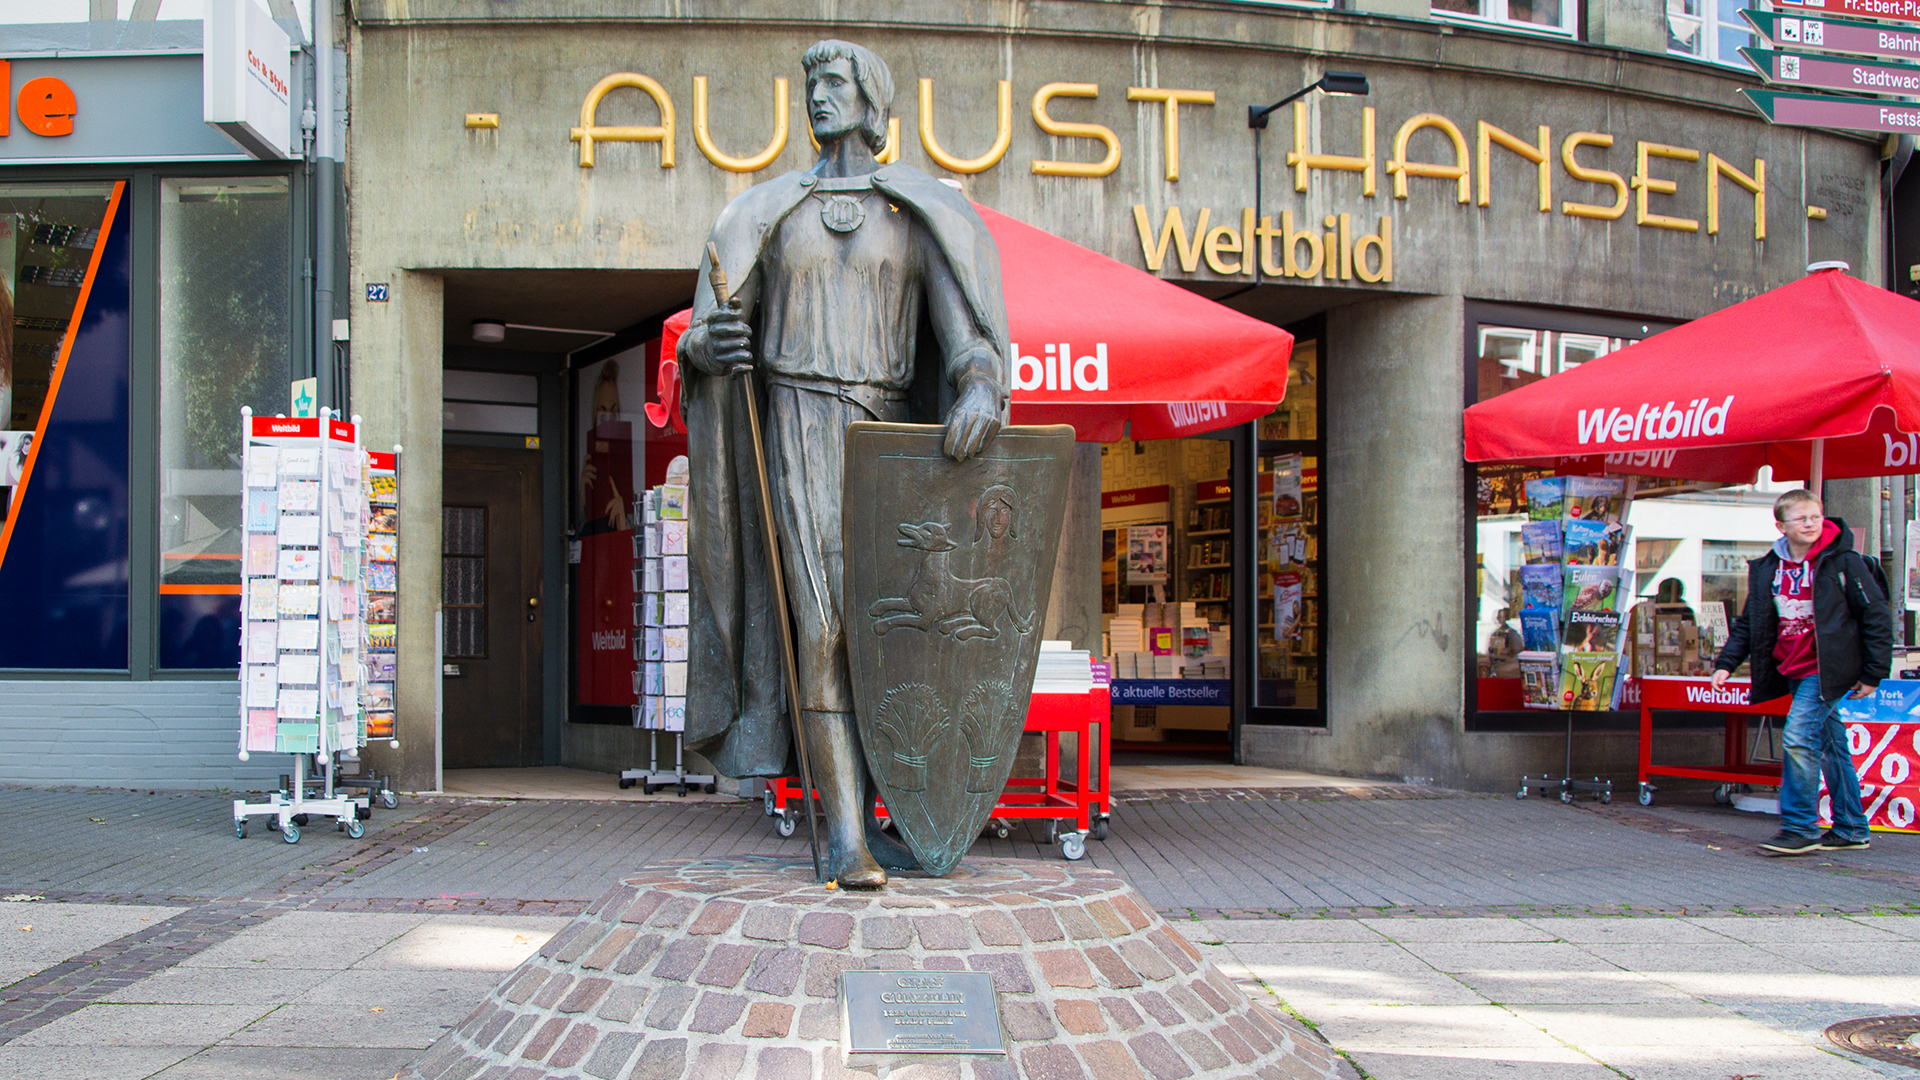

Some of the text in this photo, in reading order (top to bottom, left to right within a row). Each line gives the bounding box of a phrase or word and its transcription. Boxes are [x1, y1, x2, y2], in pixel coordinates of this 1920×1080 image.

[247, 49, 260, 71] Cut
[269, 69, 287, 96] Style
[1852, 67, 1920, 89] Stadtwac
[570, 72, 1766, 240] AUUST HANSEN
[1132, 203, 1393, 283] Weltbild
[369, 285, 386, 300] 27
[271, 424, 300, 433] Weltbild
[1577, 395, 1734, 445] Weltbild
[1572, 570, 1597, 583] Eulen
[1571, 611, 1618, 623] Eichhörnchen
[592, 629, 626, 650] Weltbild
[1111, 685, 1220, 699] & aktuelle Bestseller
[1687, 686, 1750, 705] Weltbild
[1879, 690, 1904, 699] York
